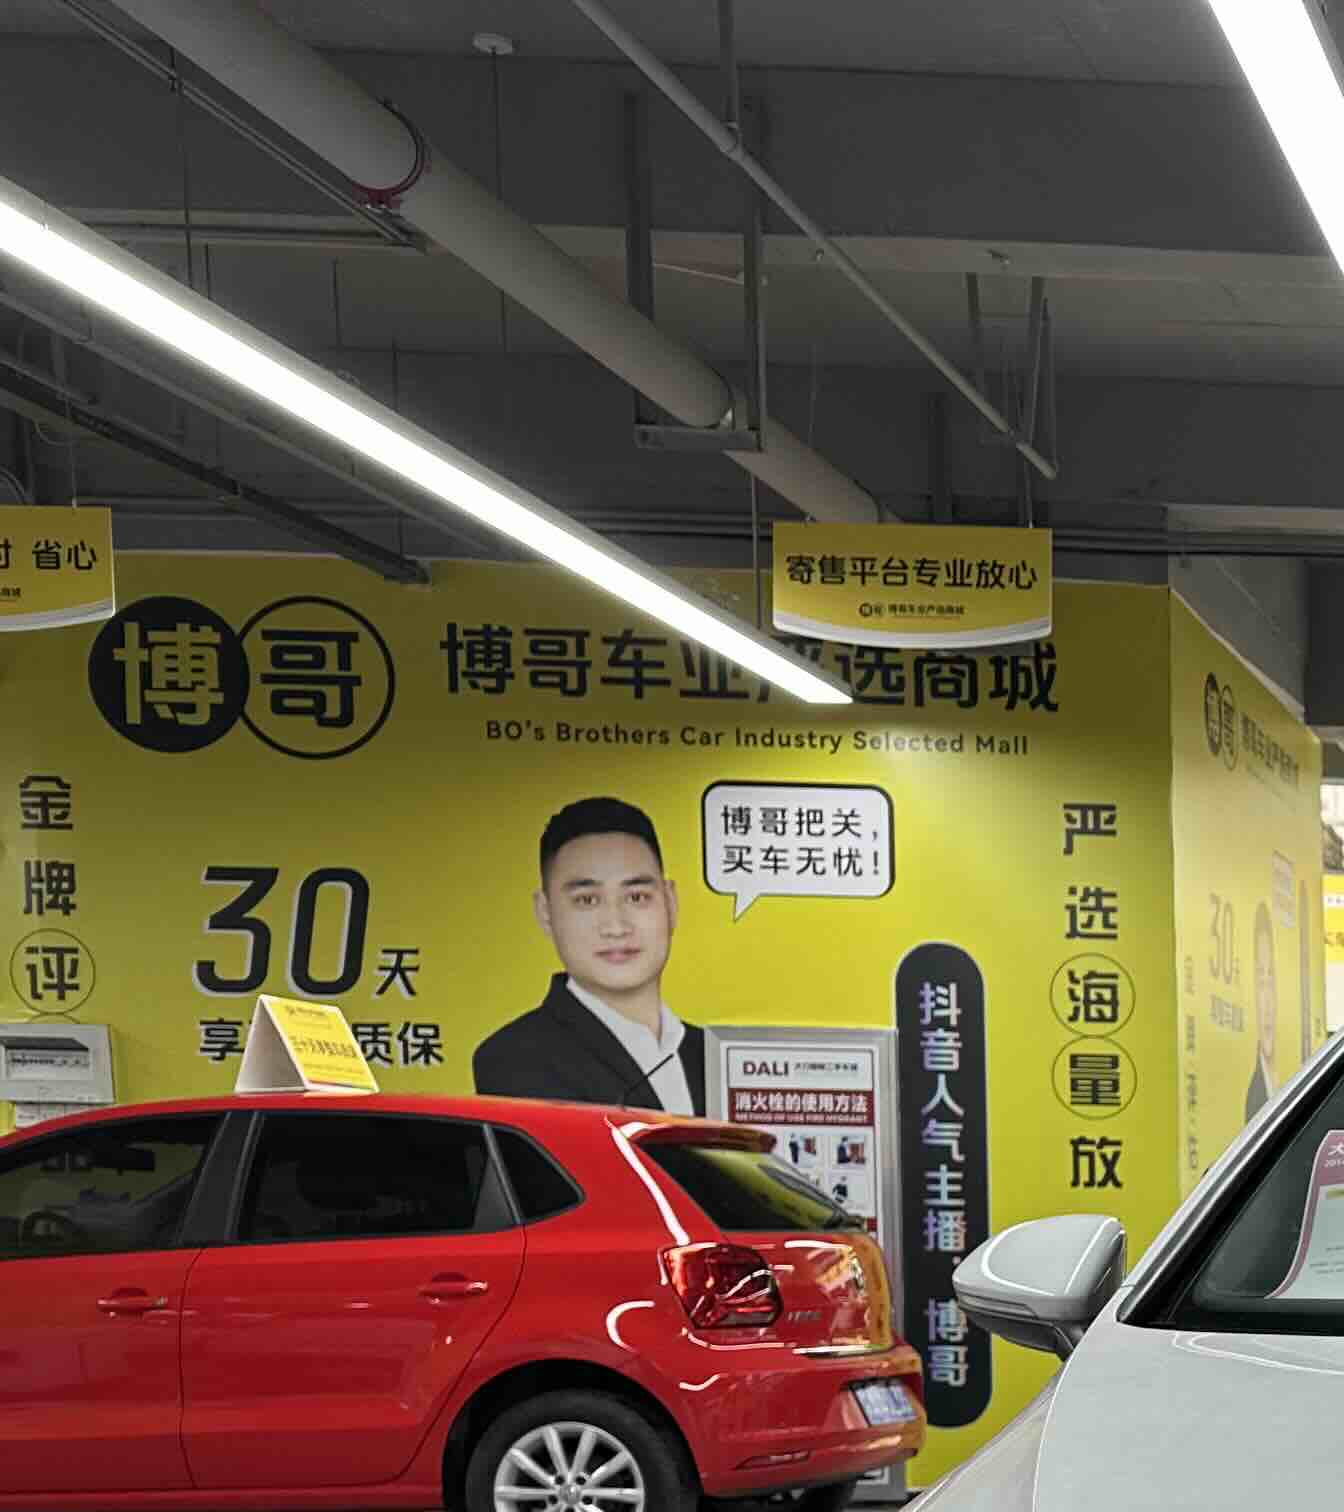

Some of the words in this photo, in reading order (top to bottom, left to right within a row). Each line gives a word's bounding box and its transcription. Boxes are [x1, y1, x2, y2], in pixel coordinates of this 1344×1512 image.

[31, 538, 97, 570] 省心
[785, 555, 1038, 591] 寄售平台专业放心
[110, 619, 364, 731] 博哥
[440, 621, 1059, 713] 博哥车业选商城
[486, 719, 545, 741] BO's
[556, 722, 671, 746] Brothers
[680, 726, 724, 746] Car
[735, 728, 842, 754] Industry
[853, 731, 965, 754] Selected
[976, 735, 1028, 756] Mall
[199, 1020, 445, 1066] 享质保
[743, 1061, 789, 1076] DALI
